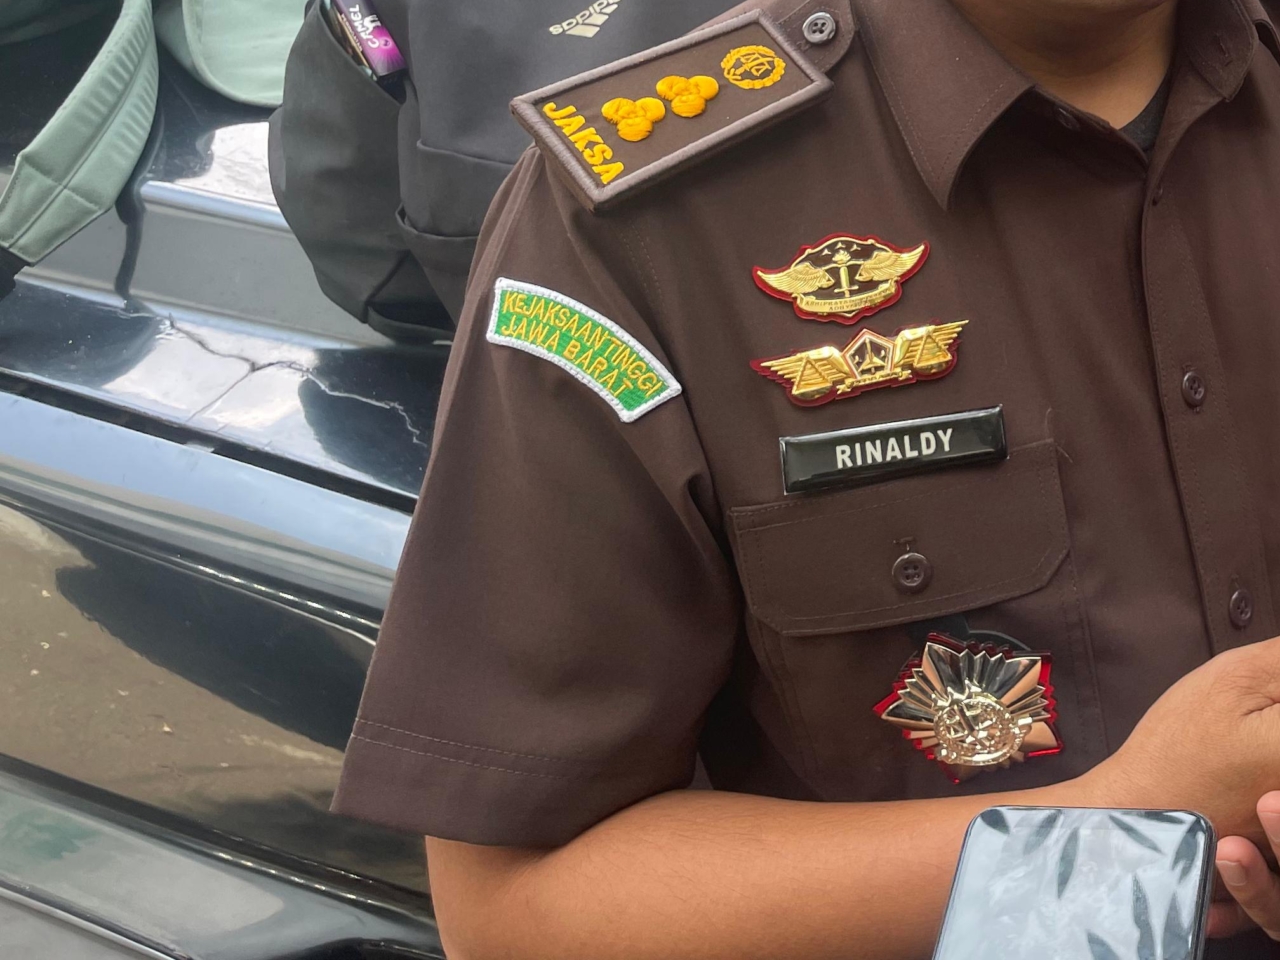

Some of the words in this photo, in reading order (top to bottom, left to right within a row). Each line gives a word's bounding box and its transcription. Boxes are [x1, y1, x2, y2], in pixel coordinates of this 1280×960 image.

[349, 4, 380, 48] CAMEL
[542, 101, 625, 185] JAKSA
[501, 315, 561, 352] JAWA
[562, 339, 634, 398] BARAT
[502, 290, 609, 351] KEJAKSAAN
[604, 337, 663, 398] TINGGI
[835, 428, 953, 469] RINALDY
